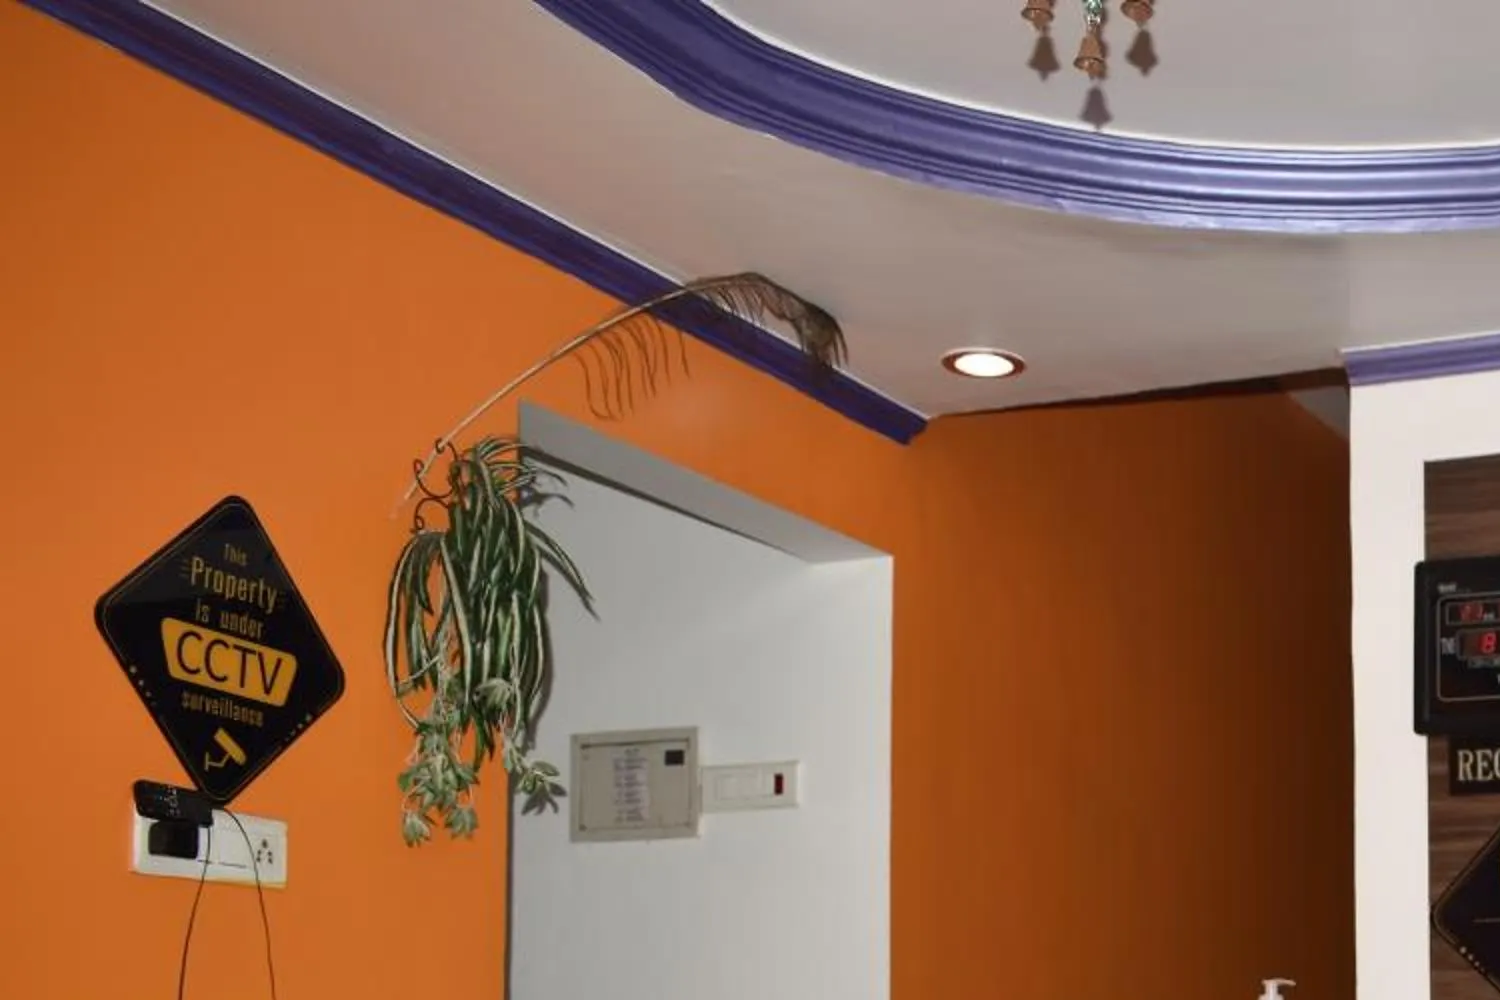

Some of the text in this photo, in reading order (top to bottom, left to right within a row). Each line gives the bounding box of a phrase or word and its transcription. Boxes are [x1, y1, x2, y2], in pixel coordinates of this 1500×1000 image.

[223, 543, 248, 566] This
[190, 556, 277, 614] Property
[220, 607, 265, 638] under
[176, 629, 282, 696] CCTV
[182, 690, 264, 727] surveillance
